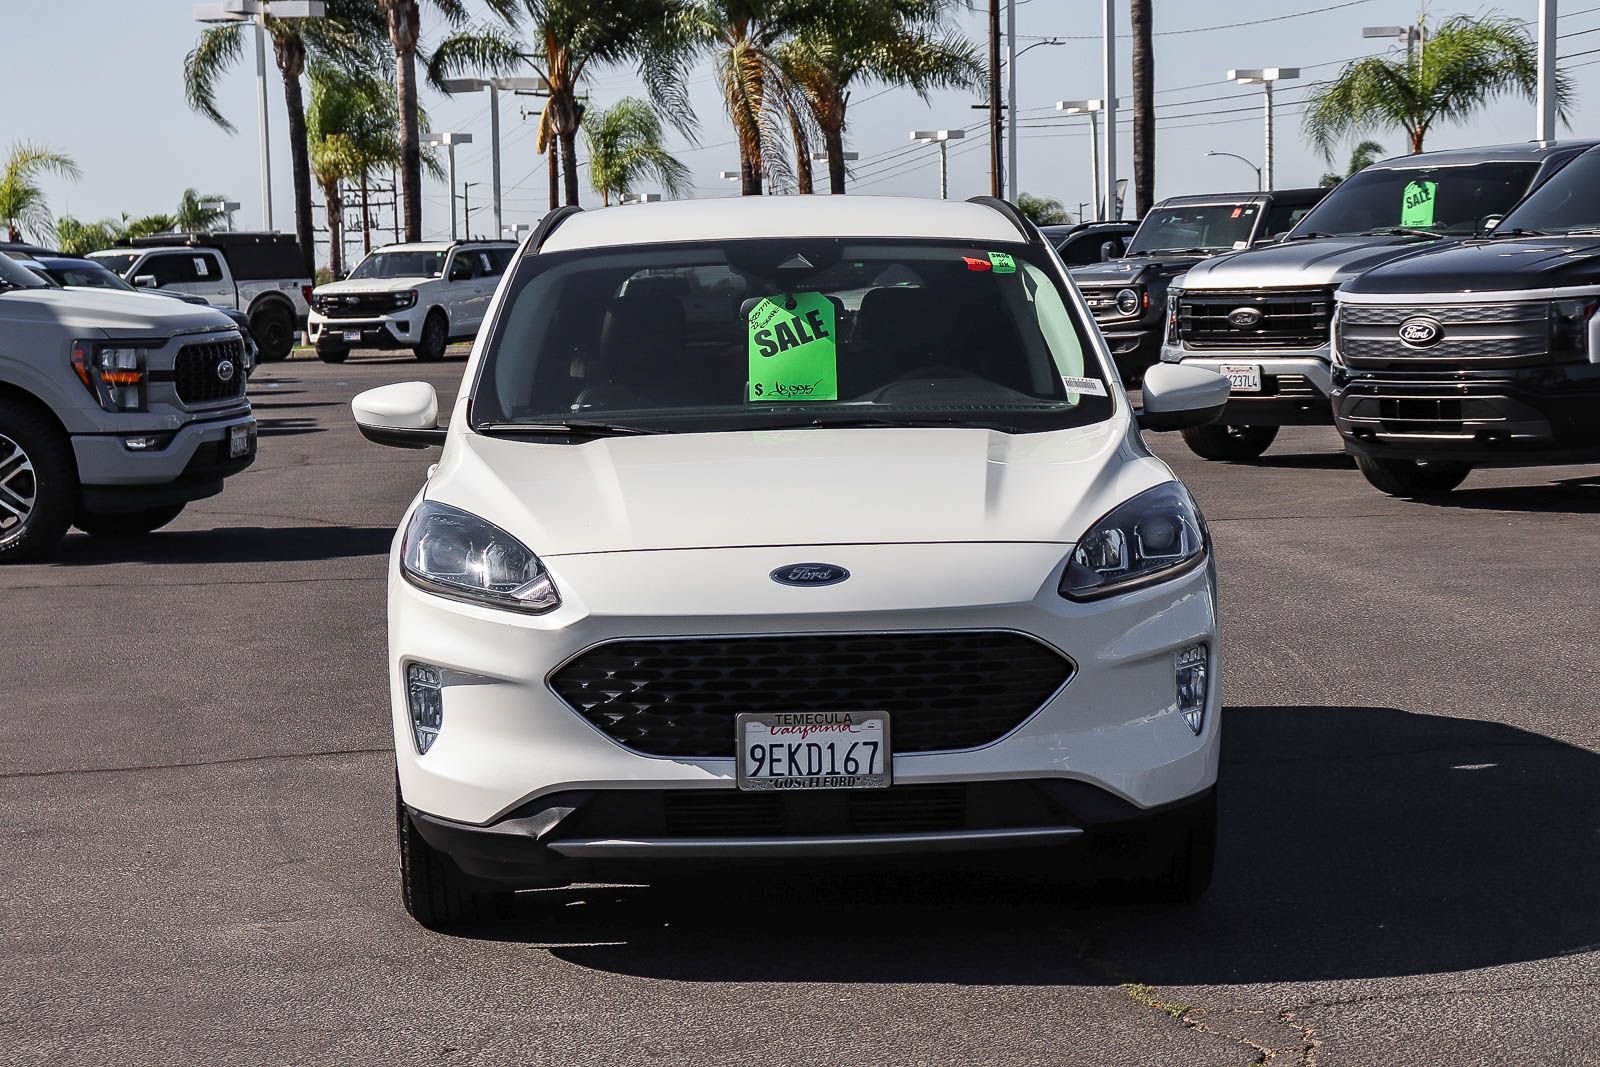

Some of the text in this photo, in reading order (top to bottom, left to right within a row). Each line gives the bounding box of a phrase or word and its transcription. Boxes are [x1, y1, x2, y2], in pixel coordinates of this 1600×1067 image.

[1406, 188, 1432, 209] SALE
[754, 309, 830, 358] SALE
[1404, 325, 1430, 339] Ford
[754, 383, 764, 396] $
[788, 566, 832, 580] Ford
[775, 713, 853, 725] TEMECULA
[770, 724, 862, 740] California
[749, 741, 879, 777] 9EKD167
[823, 776, 855, 788] FORD
